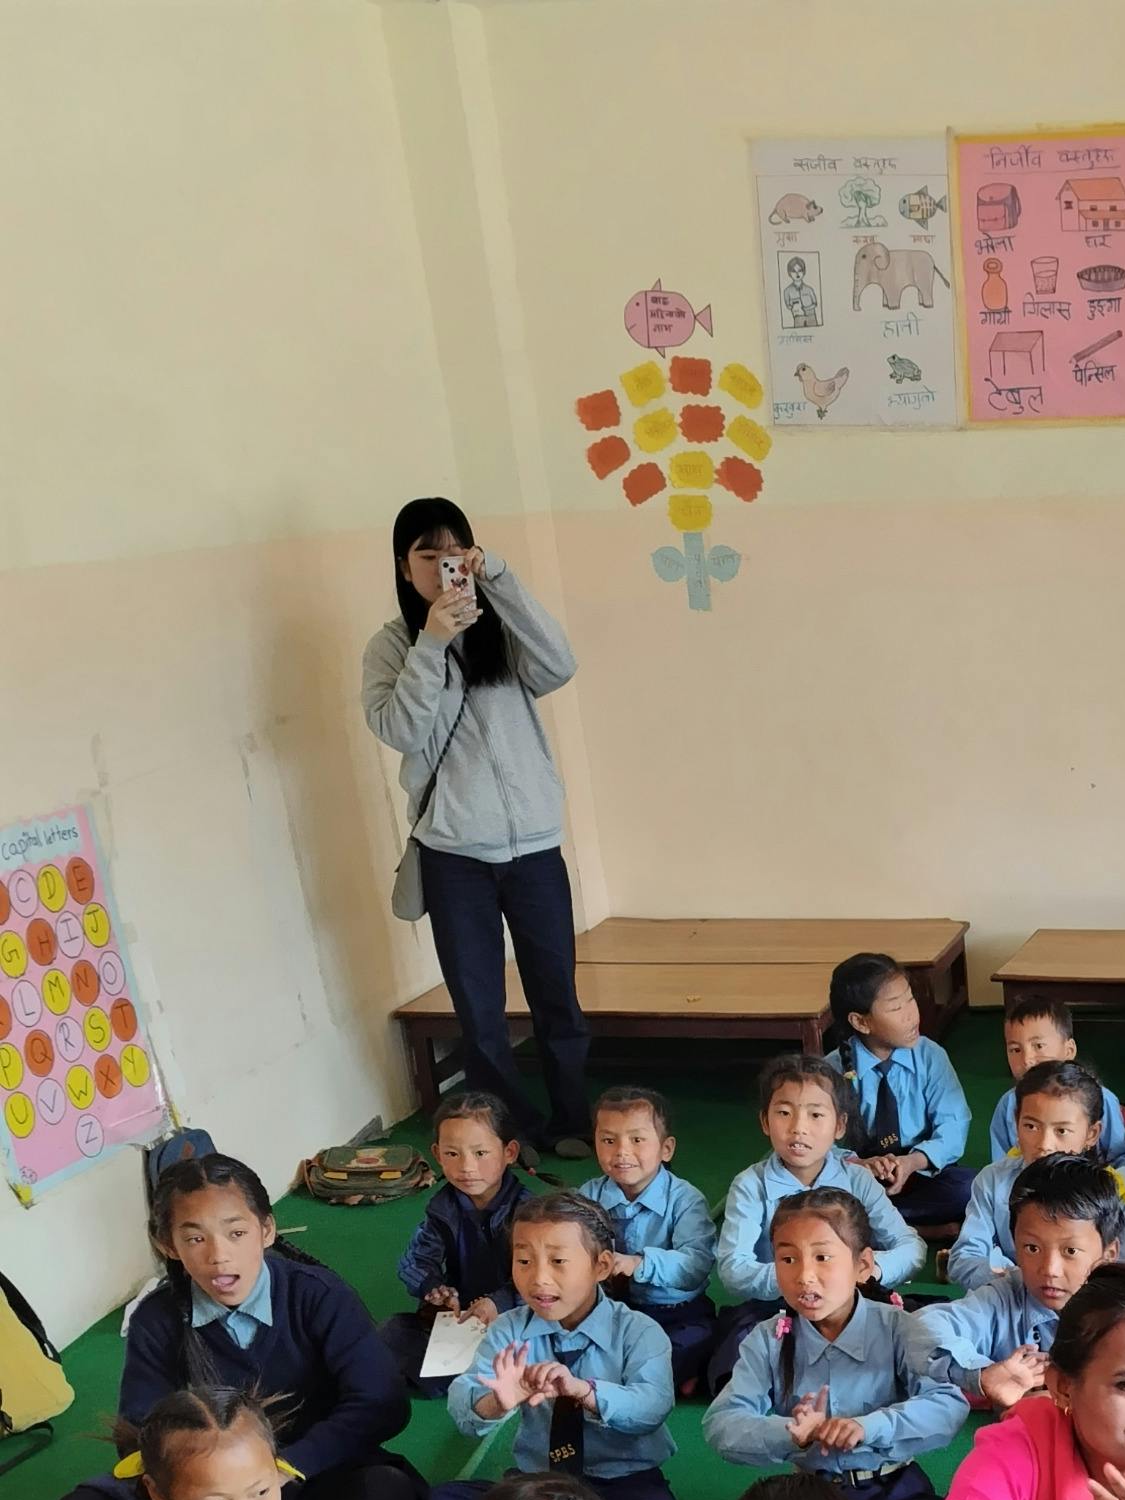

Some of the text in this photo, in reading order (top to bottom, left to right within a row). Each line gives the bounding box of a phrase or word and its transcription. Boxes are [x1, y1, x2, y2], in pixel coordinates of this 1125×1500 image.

[16, 865, 88, 903] C D E
[2, 909, 100, 963] G H I J
[18, 961, 117, 1016] L M N O
[30, 1037, 53, 1064] Q
[59, 1021, 76, 1051] R
[89, 1013, 106, 1044] S
[114, 1003, 130, 1029] T
[10, 1047, 137, 1124] U V W X Y
[81, 1121, 98, 1144] Z
[549, 1443, 576, 1463] SPBS
